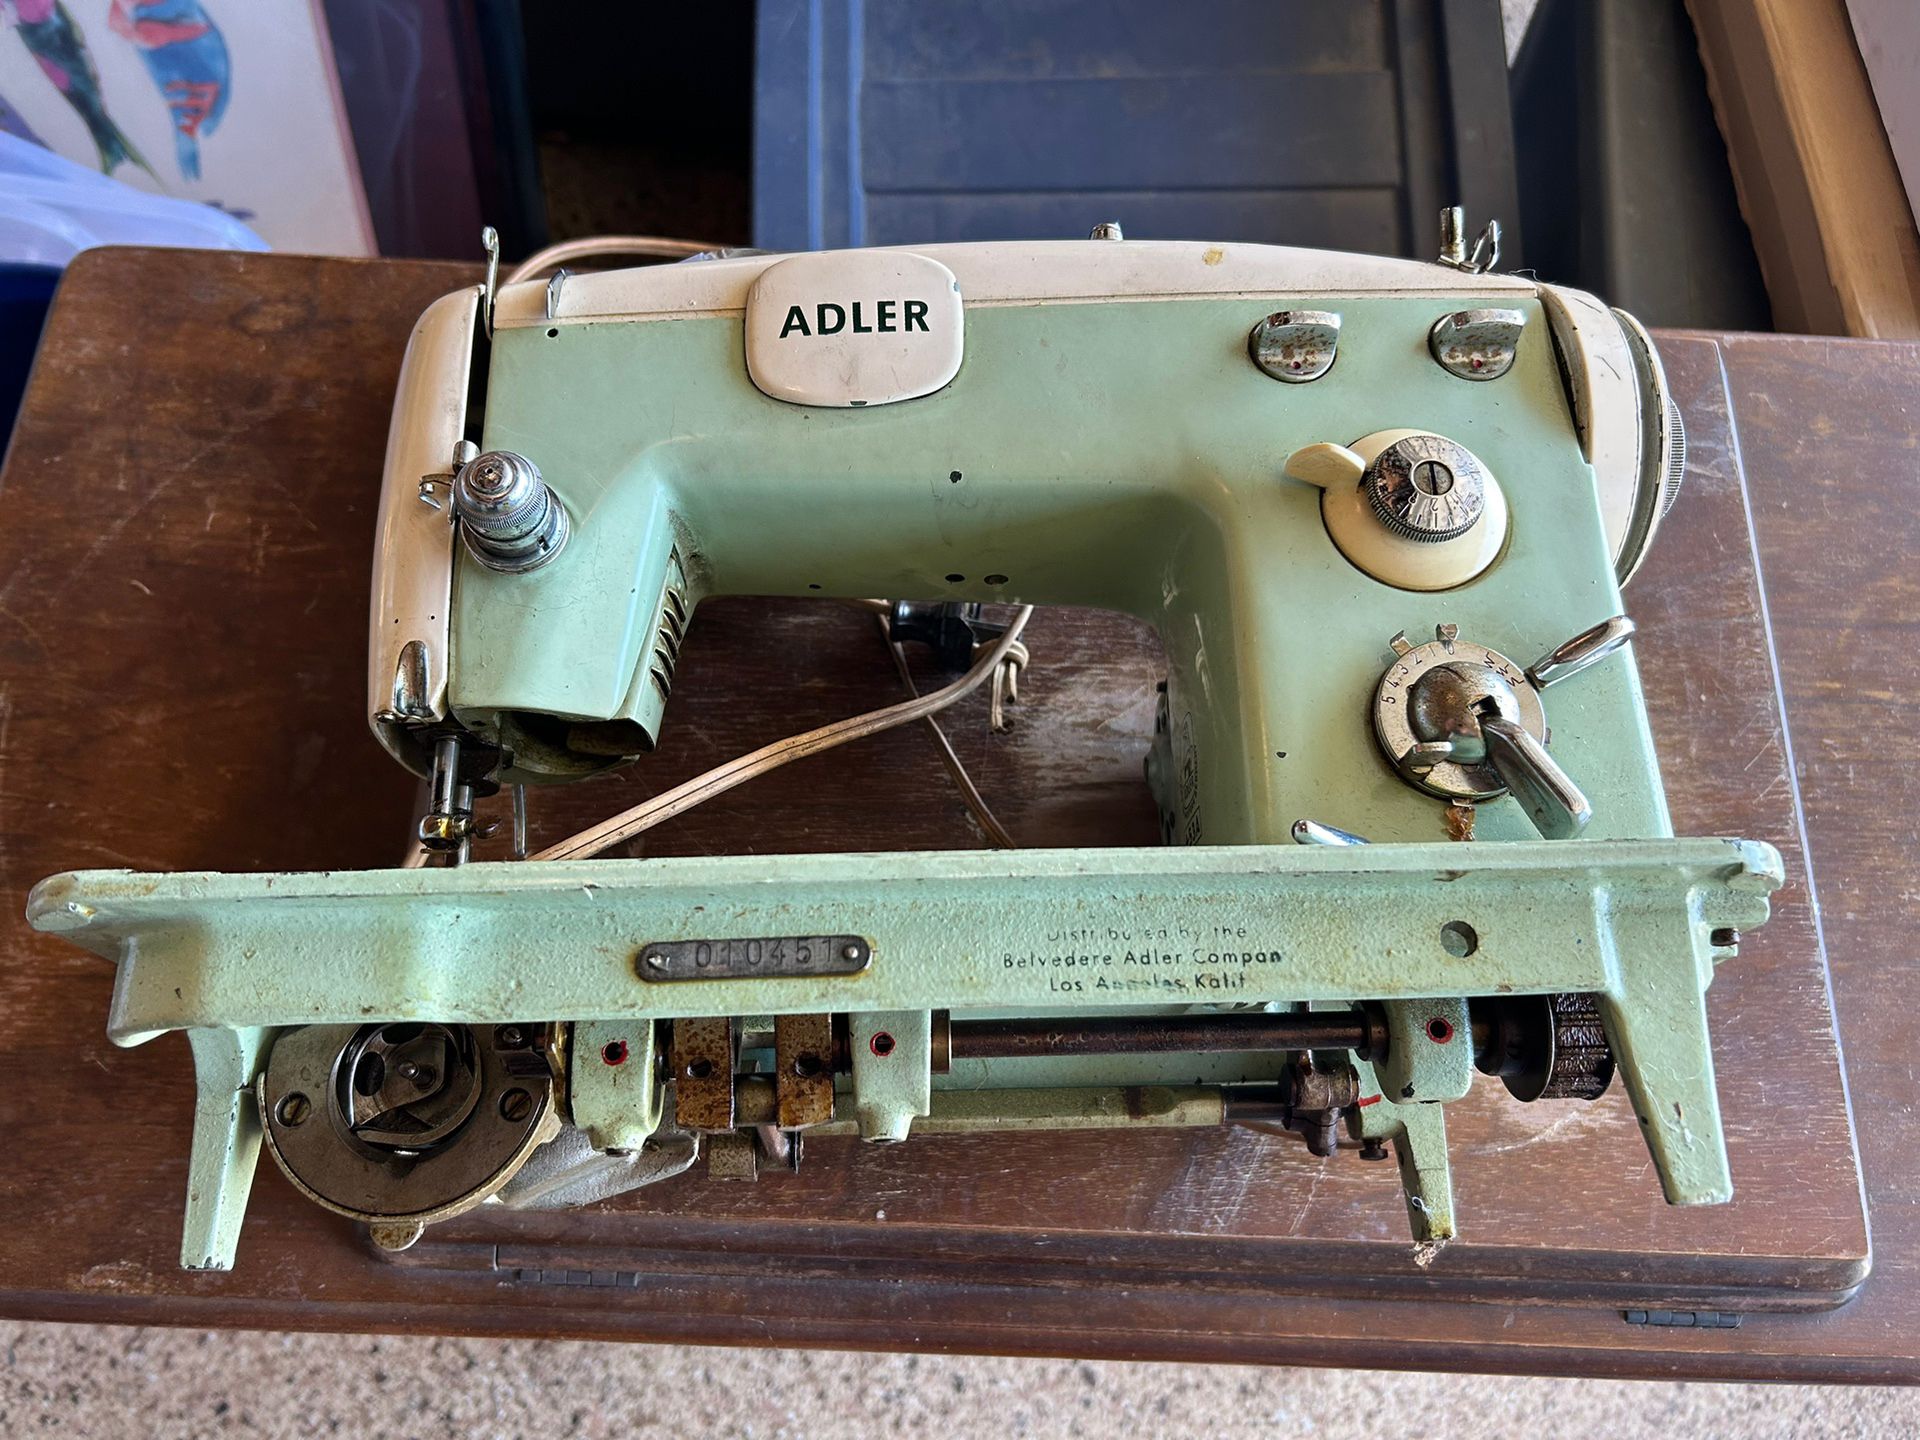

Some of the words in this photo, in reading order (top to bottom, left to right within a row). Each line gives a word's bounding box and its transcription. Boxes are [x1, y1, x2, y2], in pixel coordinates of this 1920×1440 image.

[779, 300, 930, 338] ADLER
[1409, 651, 1423, 665] 2
[1428, 645, 1436, 657] 1
[1395, 663, 1409, 675] 3
[1385, 679, 1400, 688] 4
[1381, 695, 1396, 704] 5
[1047, 926, 1168, 941] Distrbued
[1213, 925, 1248, 939] the
[1003, 951, 1112, 968] Belvedere
[1124, 949, 1182, 966] Adler
[1050, 976, 1083, 992] Los
